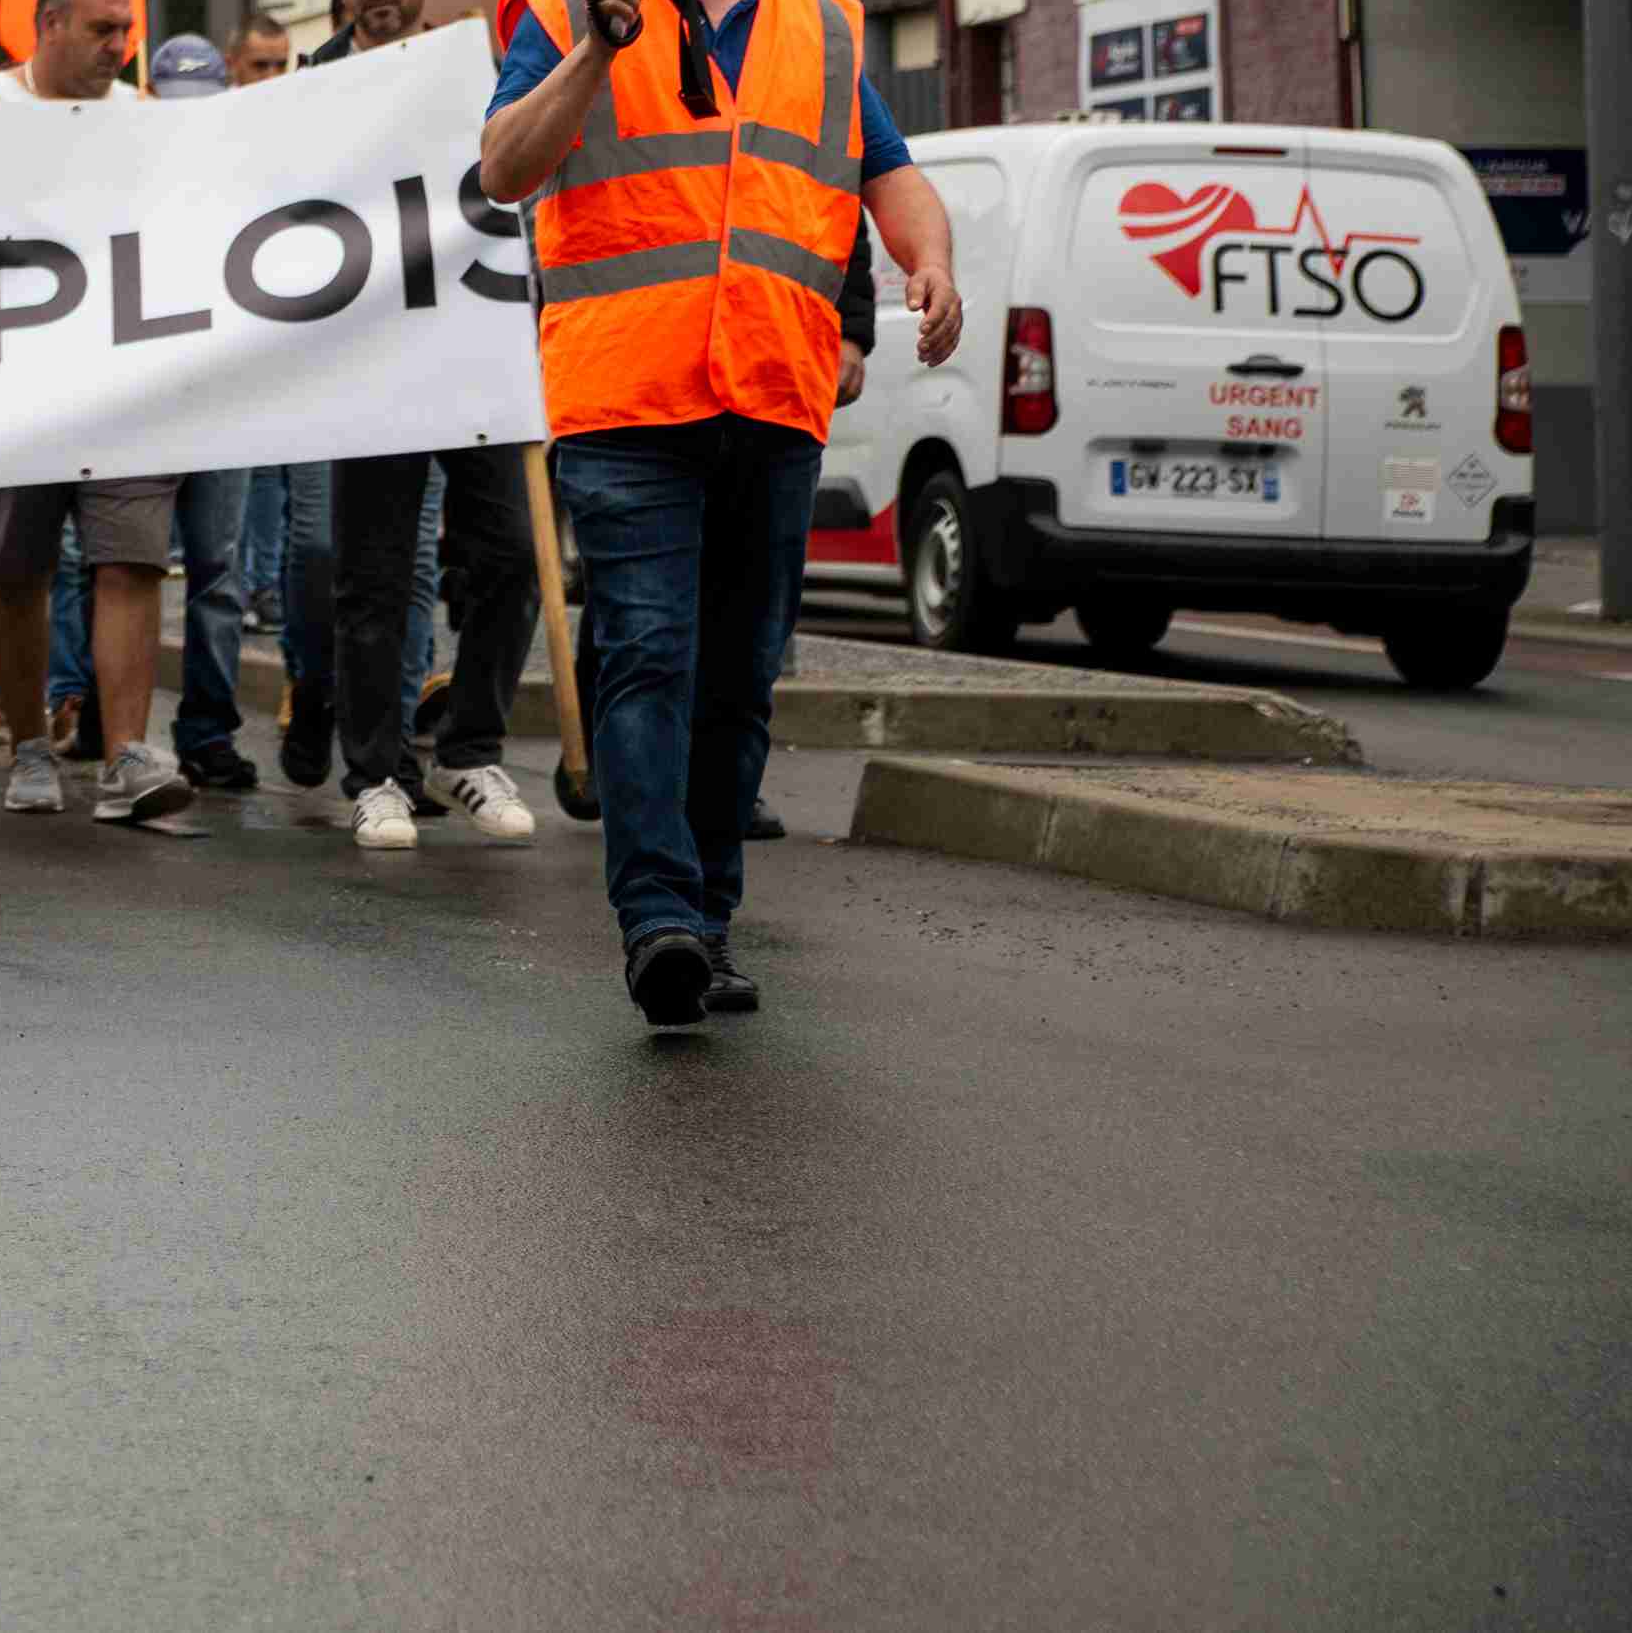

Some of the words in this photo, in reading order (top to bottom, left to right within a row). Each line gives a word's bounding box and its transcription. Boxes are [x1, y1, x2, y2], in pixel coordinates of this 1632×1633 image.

[1212, 242, 1426, 324] FTSO
[1208, 381, 1319, 409] URGENT
[1225, 415, 1304, 439] SANG
